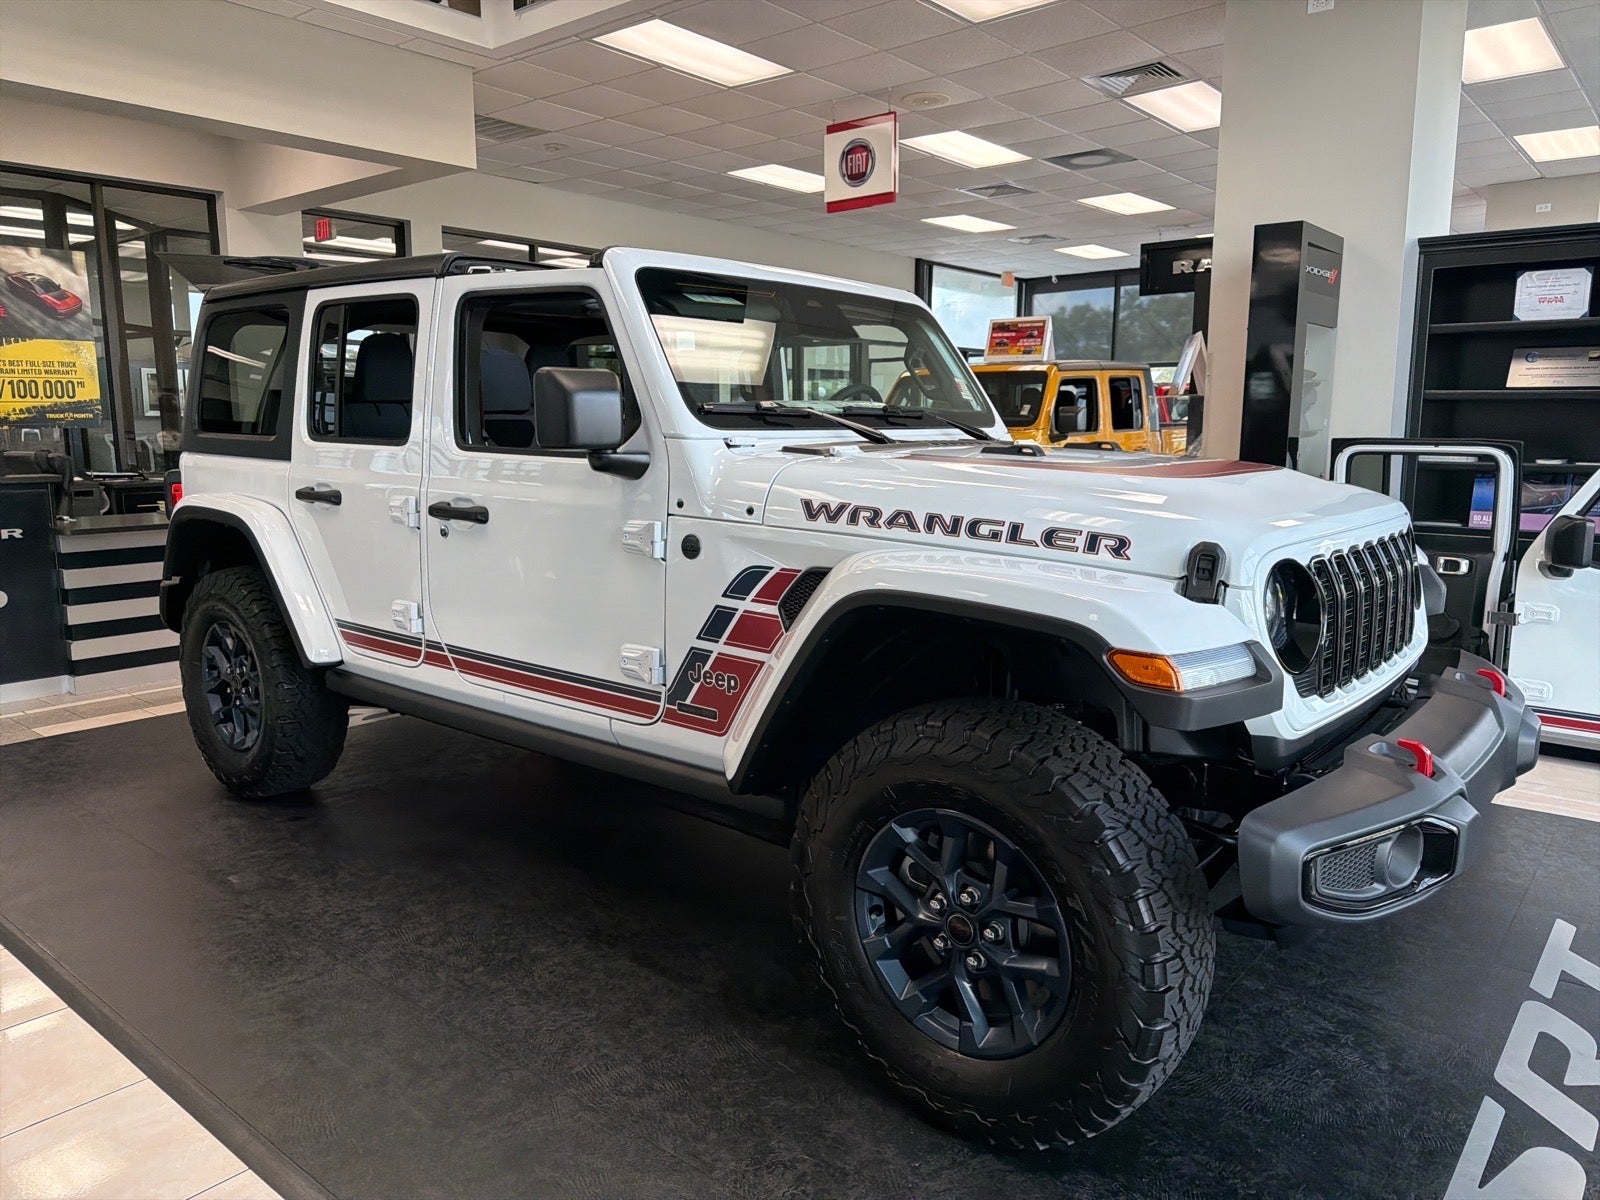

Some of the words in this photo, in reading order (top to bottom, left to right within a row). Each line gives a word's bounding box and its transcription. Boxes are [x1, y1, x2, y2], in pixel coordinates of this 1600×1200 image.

[847, 152, 868, 175] FIAT
[25, 360, 56, 368] FULL-SIZE
[57, 361, 77, 369] TRUCK
[77, 381, 86, 389] MI
[800, 498, 1132, 561] WRANGLER
[688, 662, 740, 695] Jeep
